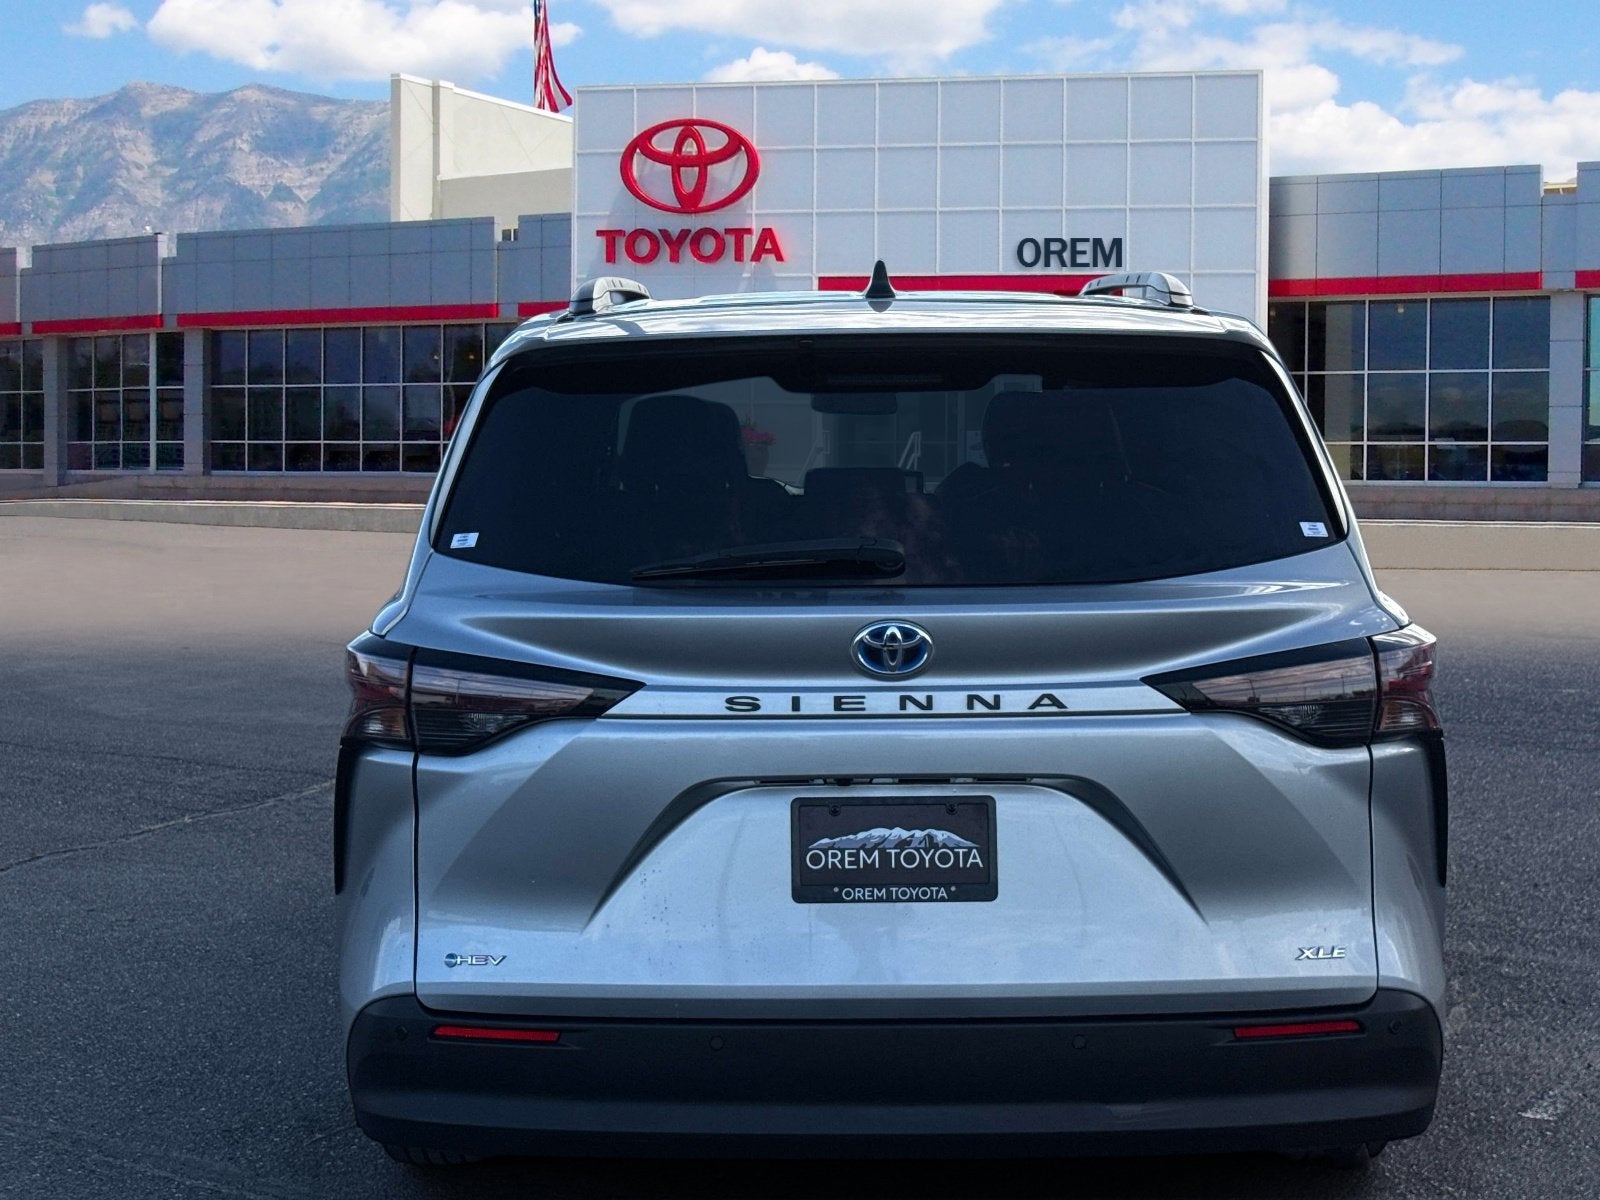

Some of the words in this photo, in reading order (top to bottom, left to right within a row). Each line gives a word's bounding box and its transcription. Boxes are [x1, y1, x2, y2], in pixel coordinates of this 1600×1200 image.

[596, 227, 785, 264] TOYOTA
[1017, 237, 1123, 268] OREM
[725, 693, 1068, 712] SIENNA
[806, 849, 879, 870] OREM
[886, 848, 984, 869] TOYOTA
[841, 887, 886, 901] OREM
[889, 886, 948, 900] TOYOTA
[456, 954, 507, 966] HEV
[1295, 945, 1347, 961] XLE
